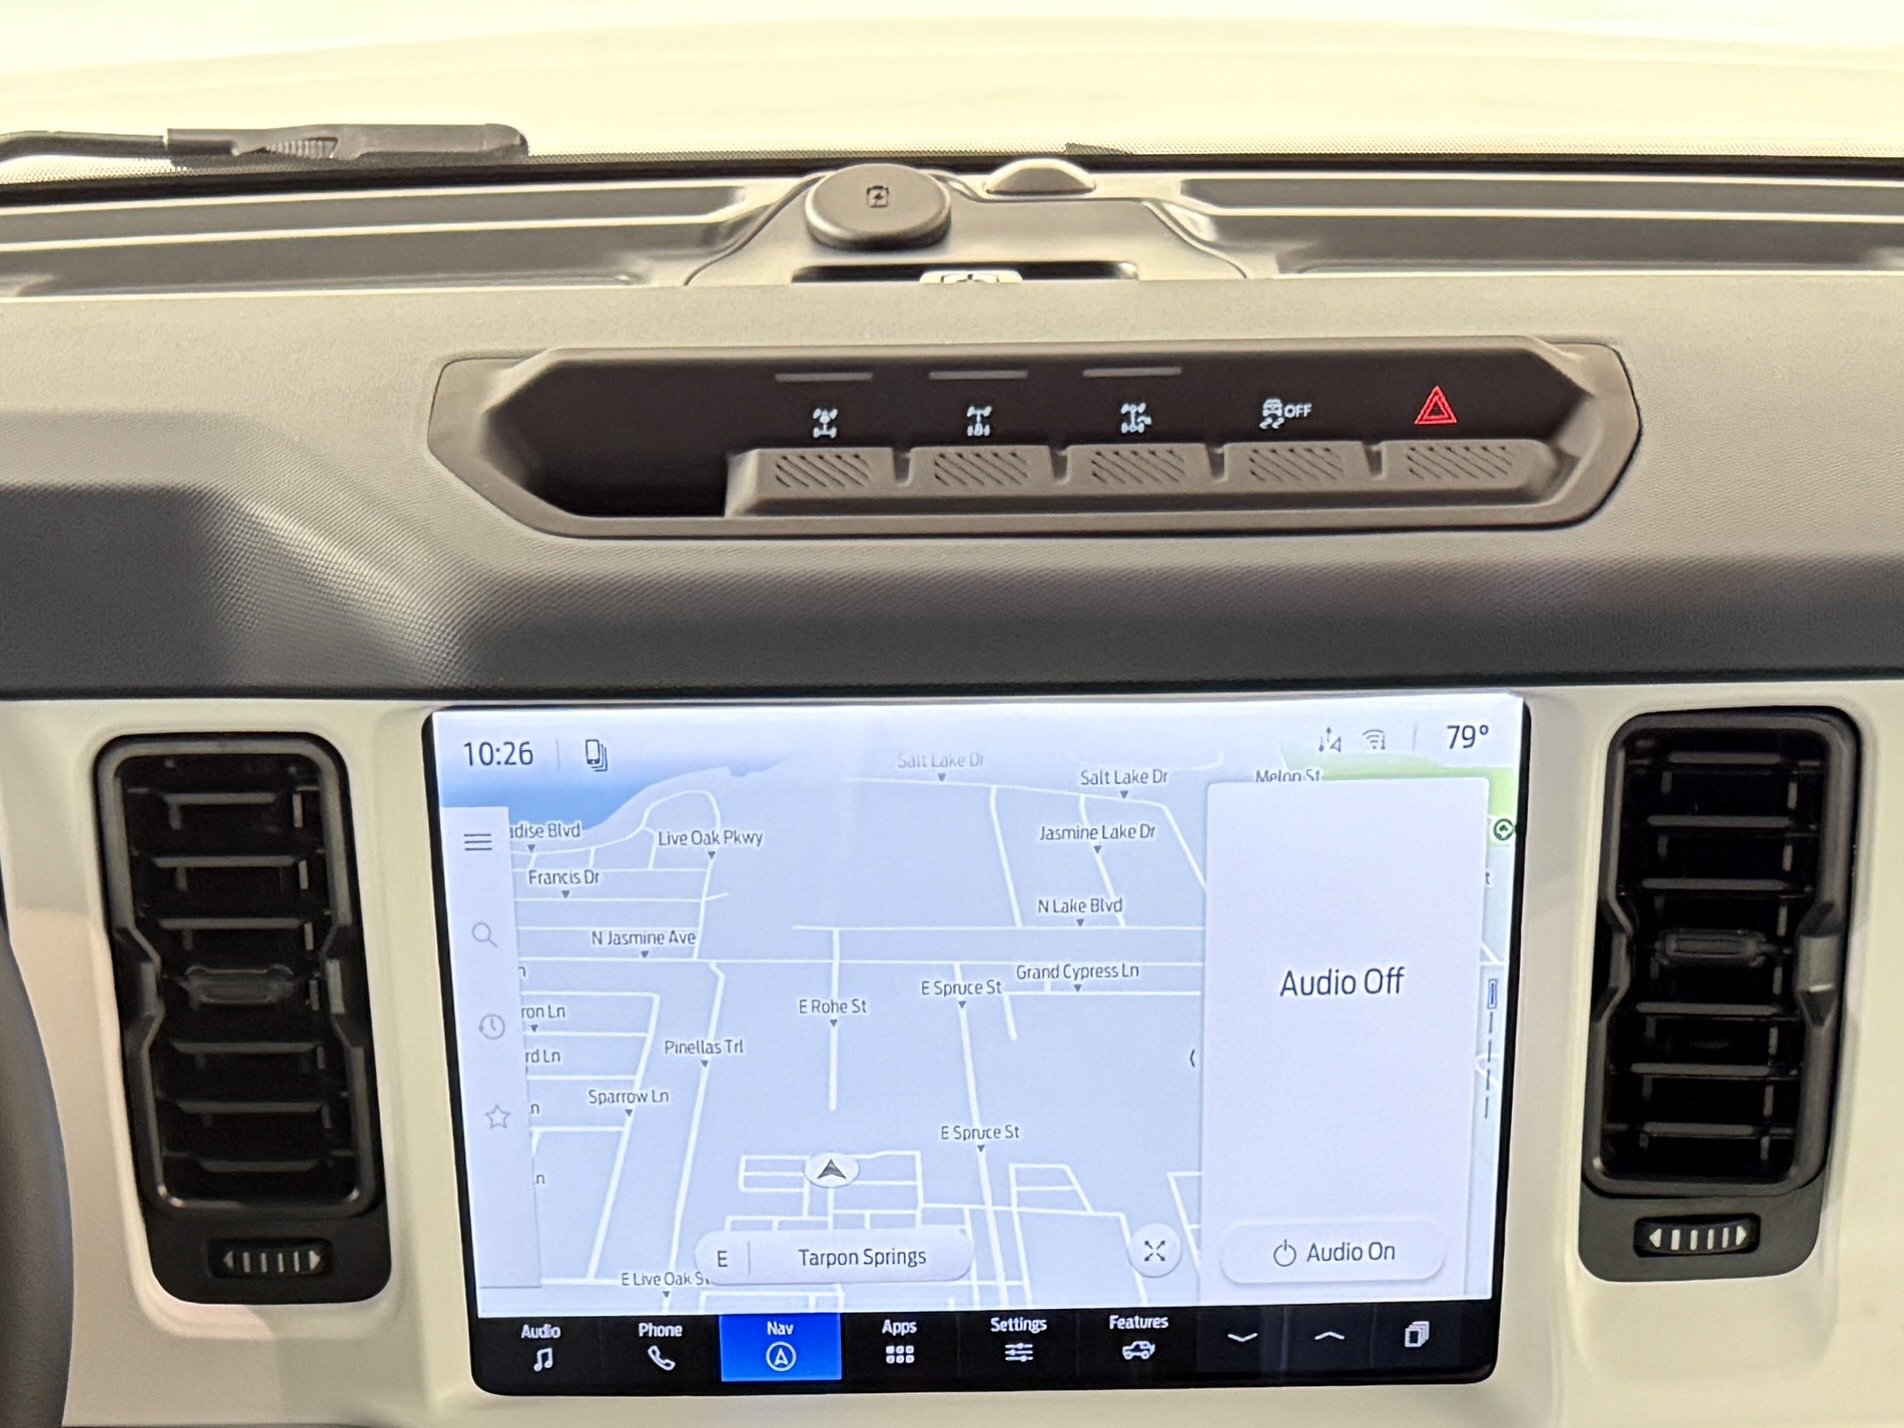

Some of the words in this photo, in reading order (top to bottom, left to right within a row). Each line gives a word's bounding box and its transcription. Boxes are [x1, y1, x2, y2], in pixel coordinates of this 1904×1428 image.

[1285, 404, 1312, 418] OFF
[1447, 724, 1489, 750] 79°
[462, 741, 534, 769] 10:26
[897, 752, 926, 769] Salt
[930, 751, 965, 768] Lake
[1080, 769, 1109, 785] Salt
[1113, 768, 1148, 785] Lake
[1151, 768, 1168, 784] Dr
[548, 822, 581, 838] Blvd
[658, 831, 688, 846] Live
[691, 830, 720, 845] Oak
[724, 830, 763, 847] Pkwy
[1039, 824, 1098, 842] Jasmine
[1101, 823, 1136, 841] Lake
[1139, 822, 1156, 840] Dr
[528, 869, 581, 885] Francis
[584, 869, 599, 884] Dr
[1037, 898, 1050, 914] N
[1052, 898, 1086, 915] Lake
[1090, 896, 1123, 914] Blvd
[592, 931, 603, 945] N
[607, 930, 665, 946] Jasmine
[668, 930, 696, 945] Ave
[1016, 964, 1059, 980] Grand
[1063, 963, 1119, 981] Cypress
[1122, 963, 1140, 978] Ln
[921, 981, 930, 995] E
[934, 980, 983, 997] Spruce
[987, 979, 1002, 995] St
[1279, 967, 1358, 998] Audio
[1363, 966, 1405, 995] Off
[548, 1004, 565, 1019] Ln
[799, 1000, 807, 1014] E
[811, 999, 848, 1014] Rohe
[851, 998, 867, 1014] St
[543, 1048, 561, 1063] Ln
[664, 1040, 722, 1055] Pinellas
[724, 1039, 744, 1054] Trl
[588, 1089, 648, 1105] Sparrow
[651, 1089, 669, 1103] Ln
[941, 1126, 950, 1140] E
[953, 1125, 1002, 1142] Spruce
[1004, 1124, 1020, 1139] St
[716, 1251, 728, 1268] E
[798, 1249, 859, 1269] Tarpon
[863, 1248, 927, 1268] Springs
[1305, 1241, 1363, 1263] Audio
[1367, 1241, 1396, 1262] On
[621, 1272, 630, 1286] E
[633, 1272, 661, 1286] Live
[664, 1272, 691, 1286] Oak
[638, 1322, 683, 1339] Phone
[766, 1320, 794, 1337] Nav
[881, 1319, 917, 1339] Apps
[990, 1316, 1048, 1335] Settings
[1108, 1314, 1169, 1331] Features
[521, 1324, 561, 1340] Audio
